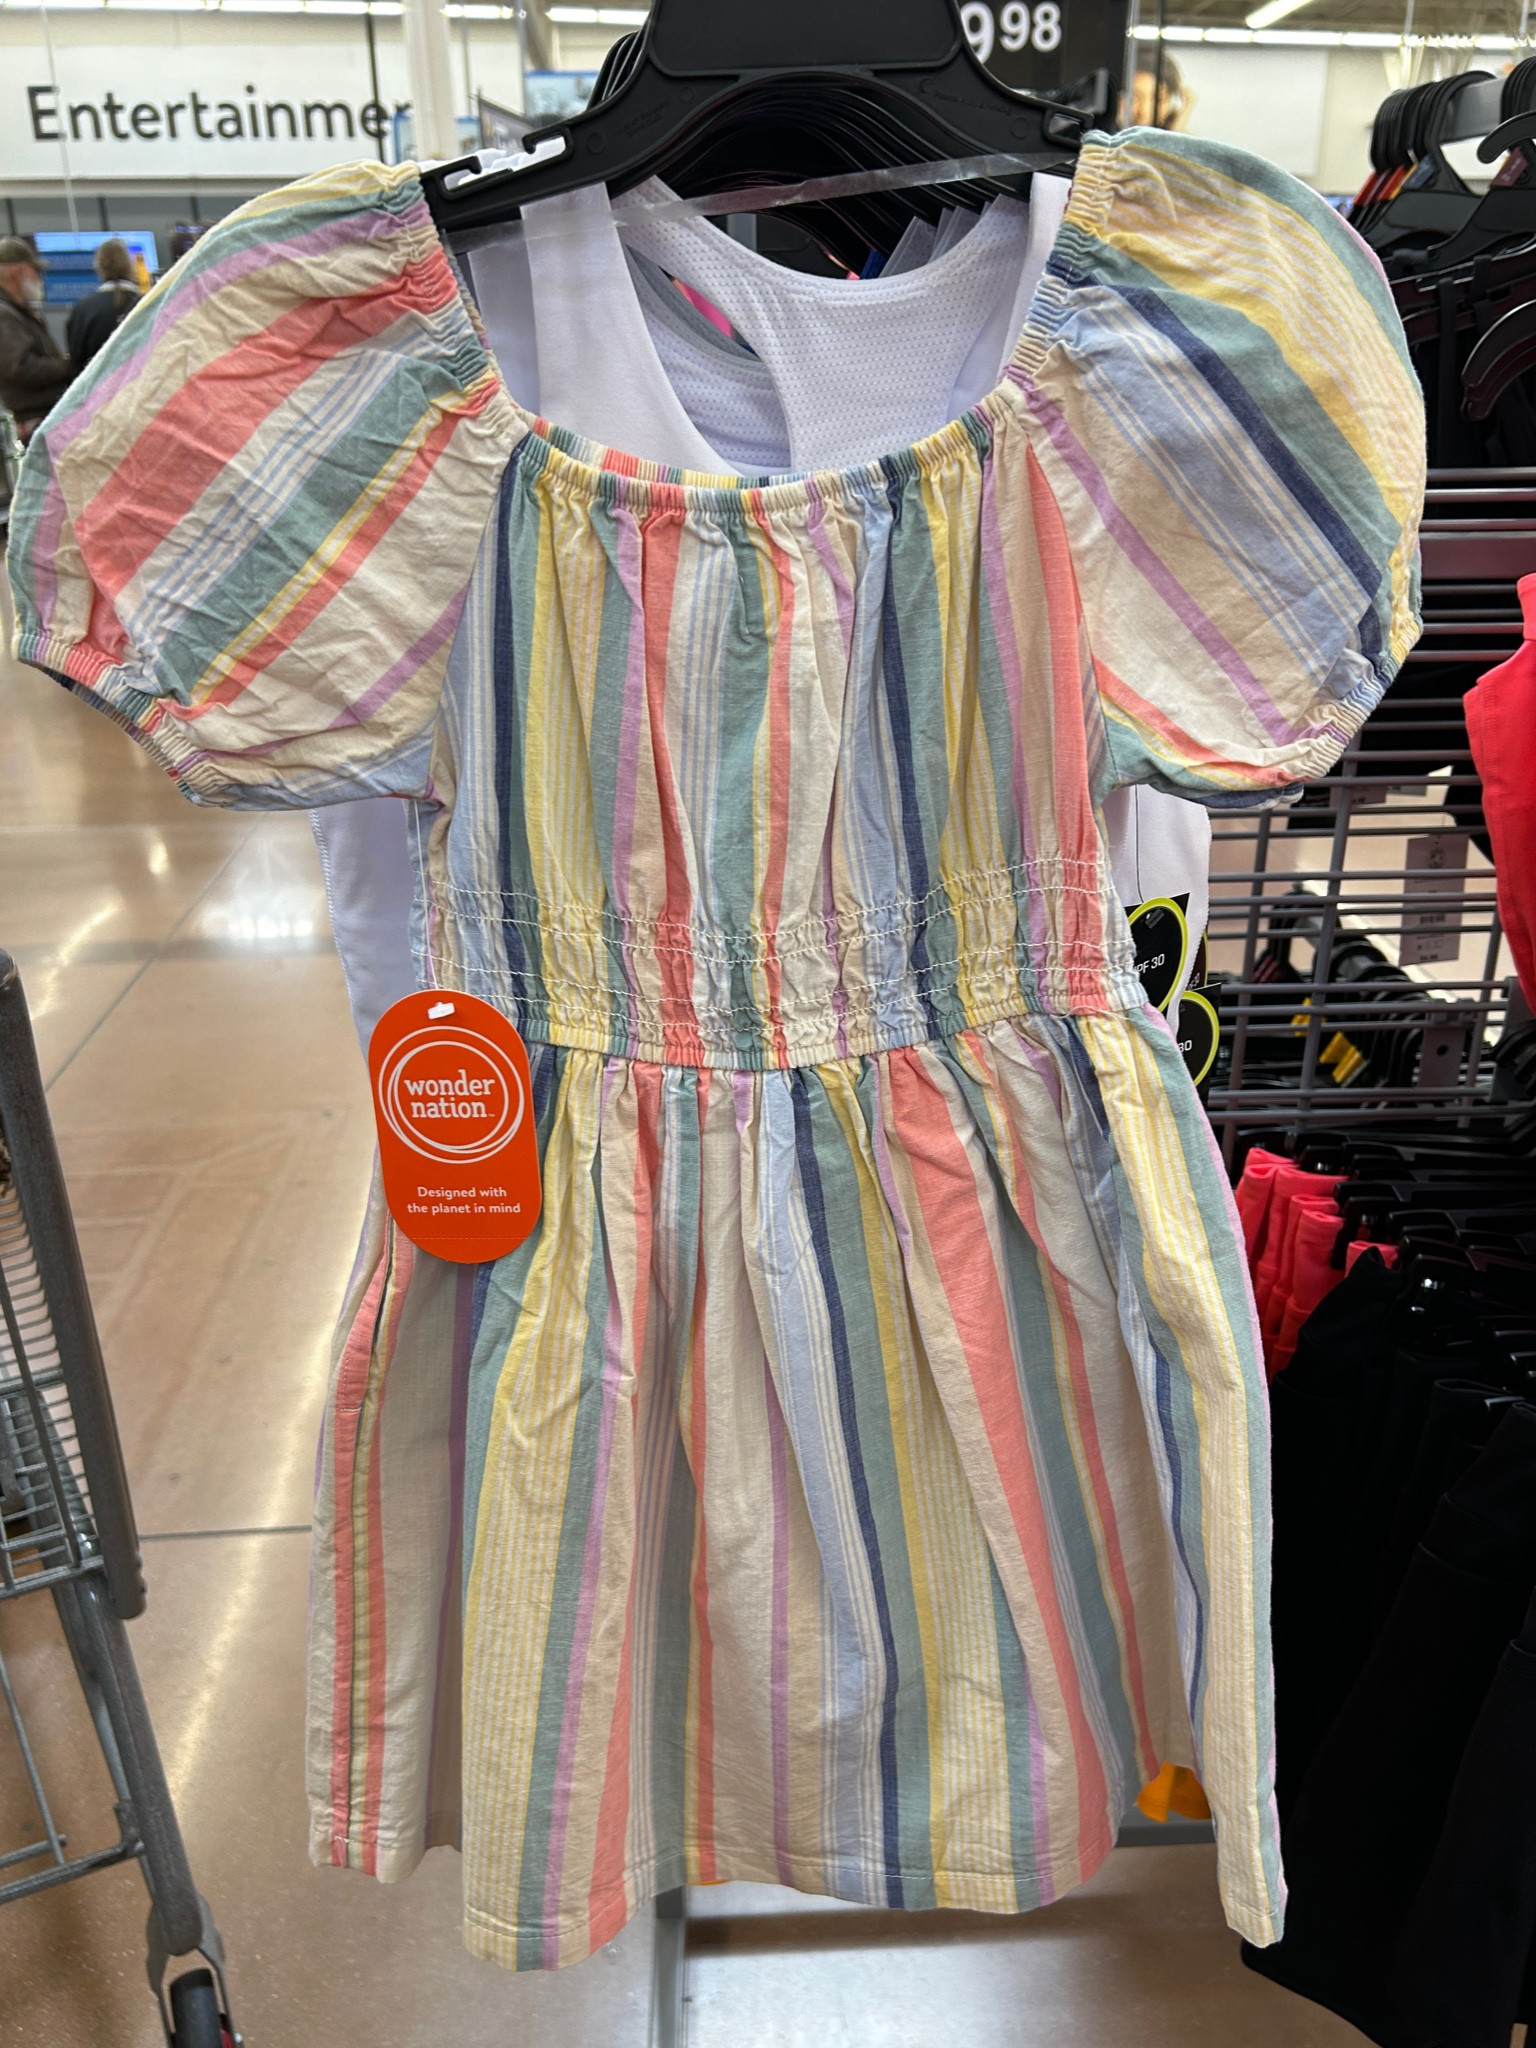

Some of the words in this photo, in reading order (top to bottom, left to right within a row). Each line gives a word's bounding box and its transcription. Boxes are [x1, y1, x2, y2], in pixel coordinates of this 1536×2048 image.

[27, 84, 411, 140] Entertainme
[1151, 953, 1165, 969] 30
[404, 1069, 495, 1096] wonder
[410, 1097, 487, 1118] nation
[417, 1186, 476, 1200] Designed
[479, 1187, 507, 1197] with
[407, 1203, 428, 1213] the
[431, 1203, 471, 1216] planet
[474, 1203, 486, 1213] in
[489, 1203, 521, 1213] mind
